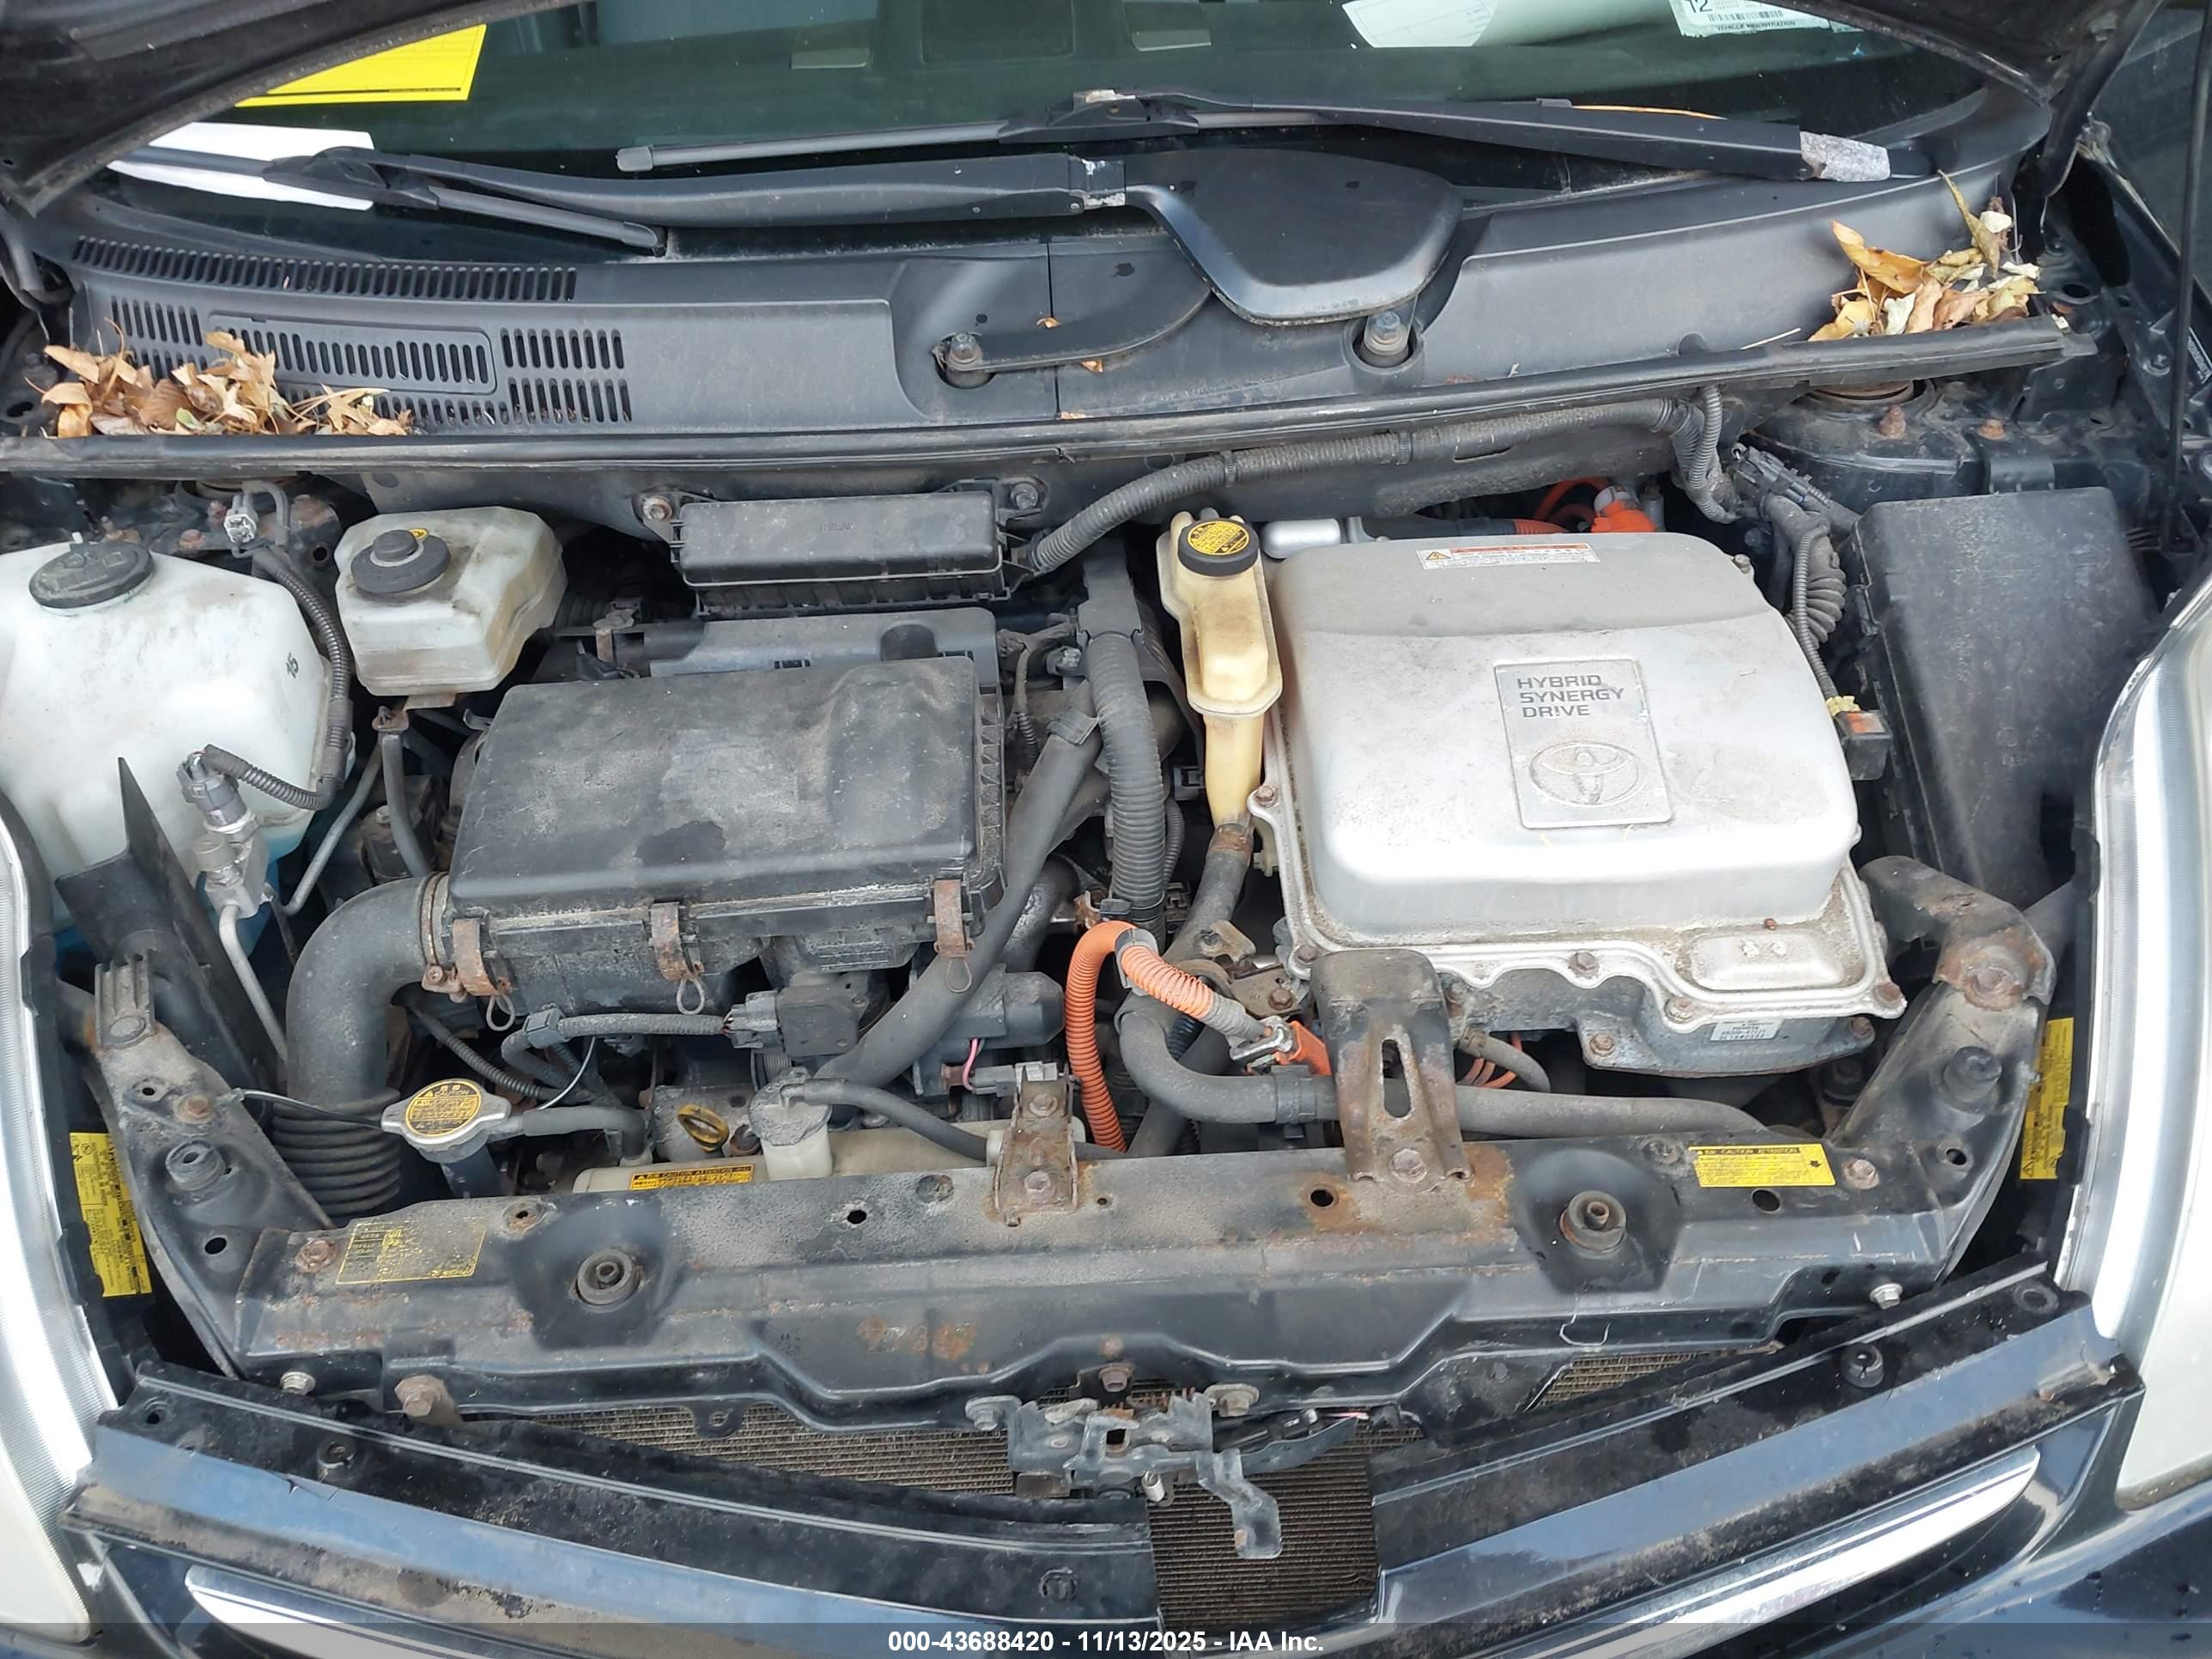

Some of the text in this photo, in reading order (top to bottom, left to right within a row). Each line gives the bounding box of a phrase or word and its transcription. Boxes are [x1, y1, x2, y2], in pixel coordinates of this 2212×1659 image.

[1516, 675, 1602, 689] HYBRID
[1519, 688, 1626, 703] SYNERGY
[1522, 704, 1591, 718] DRIVE
